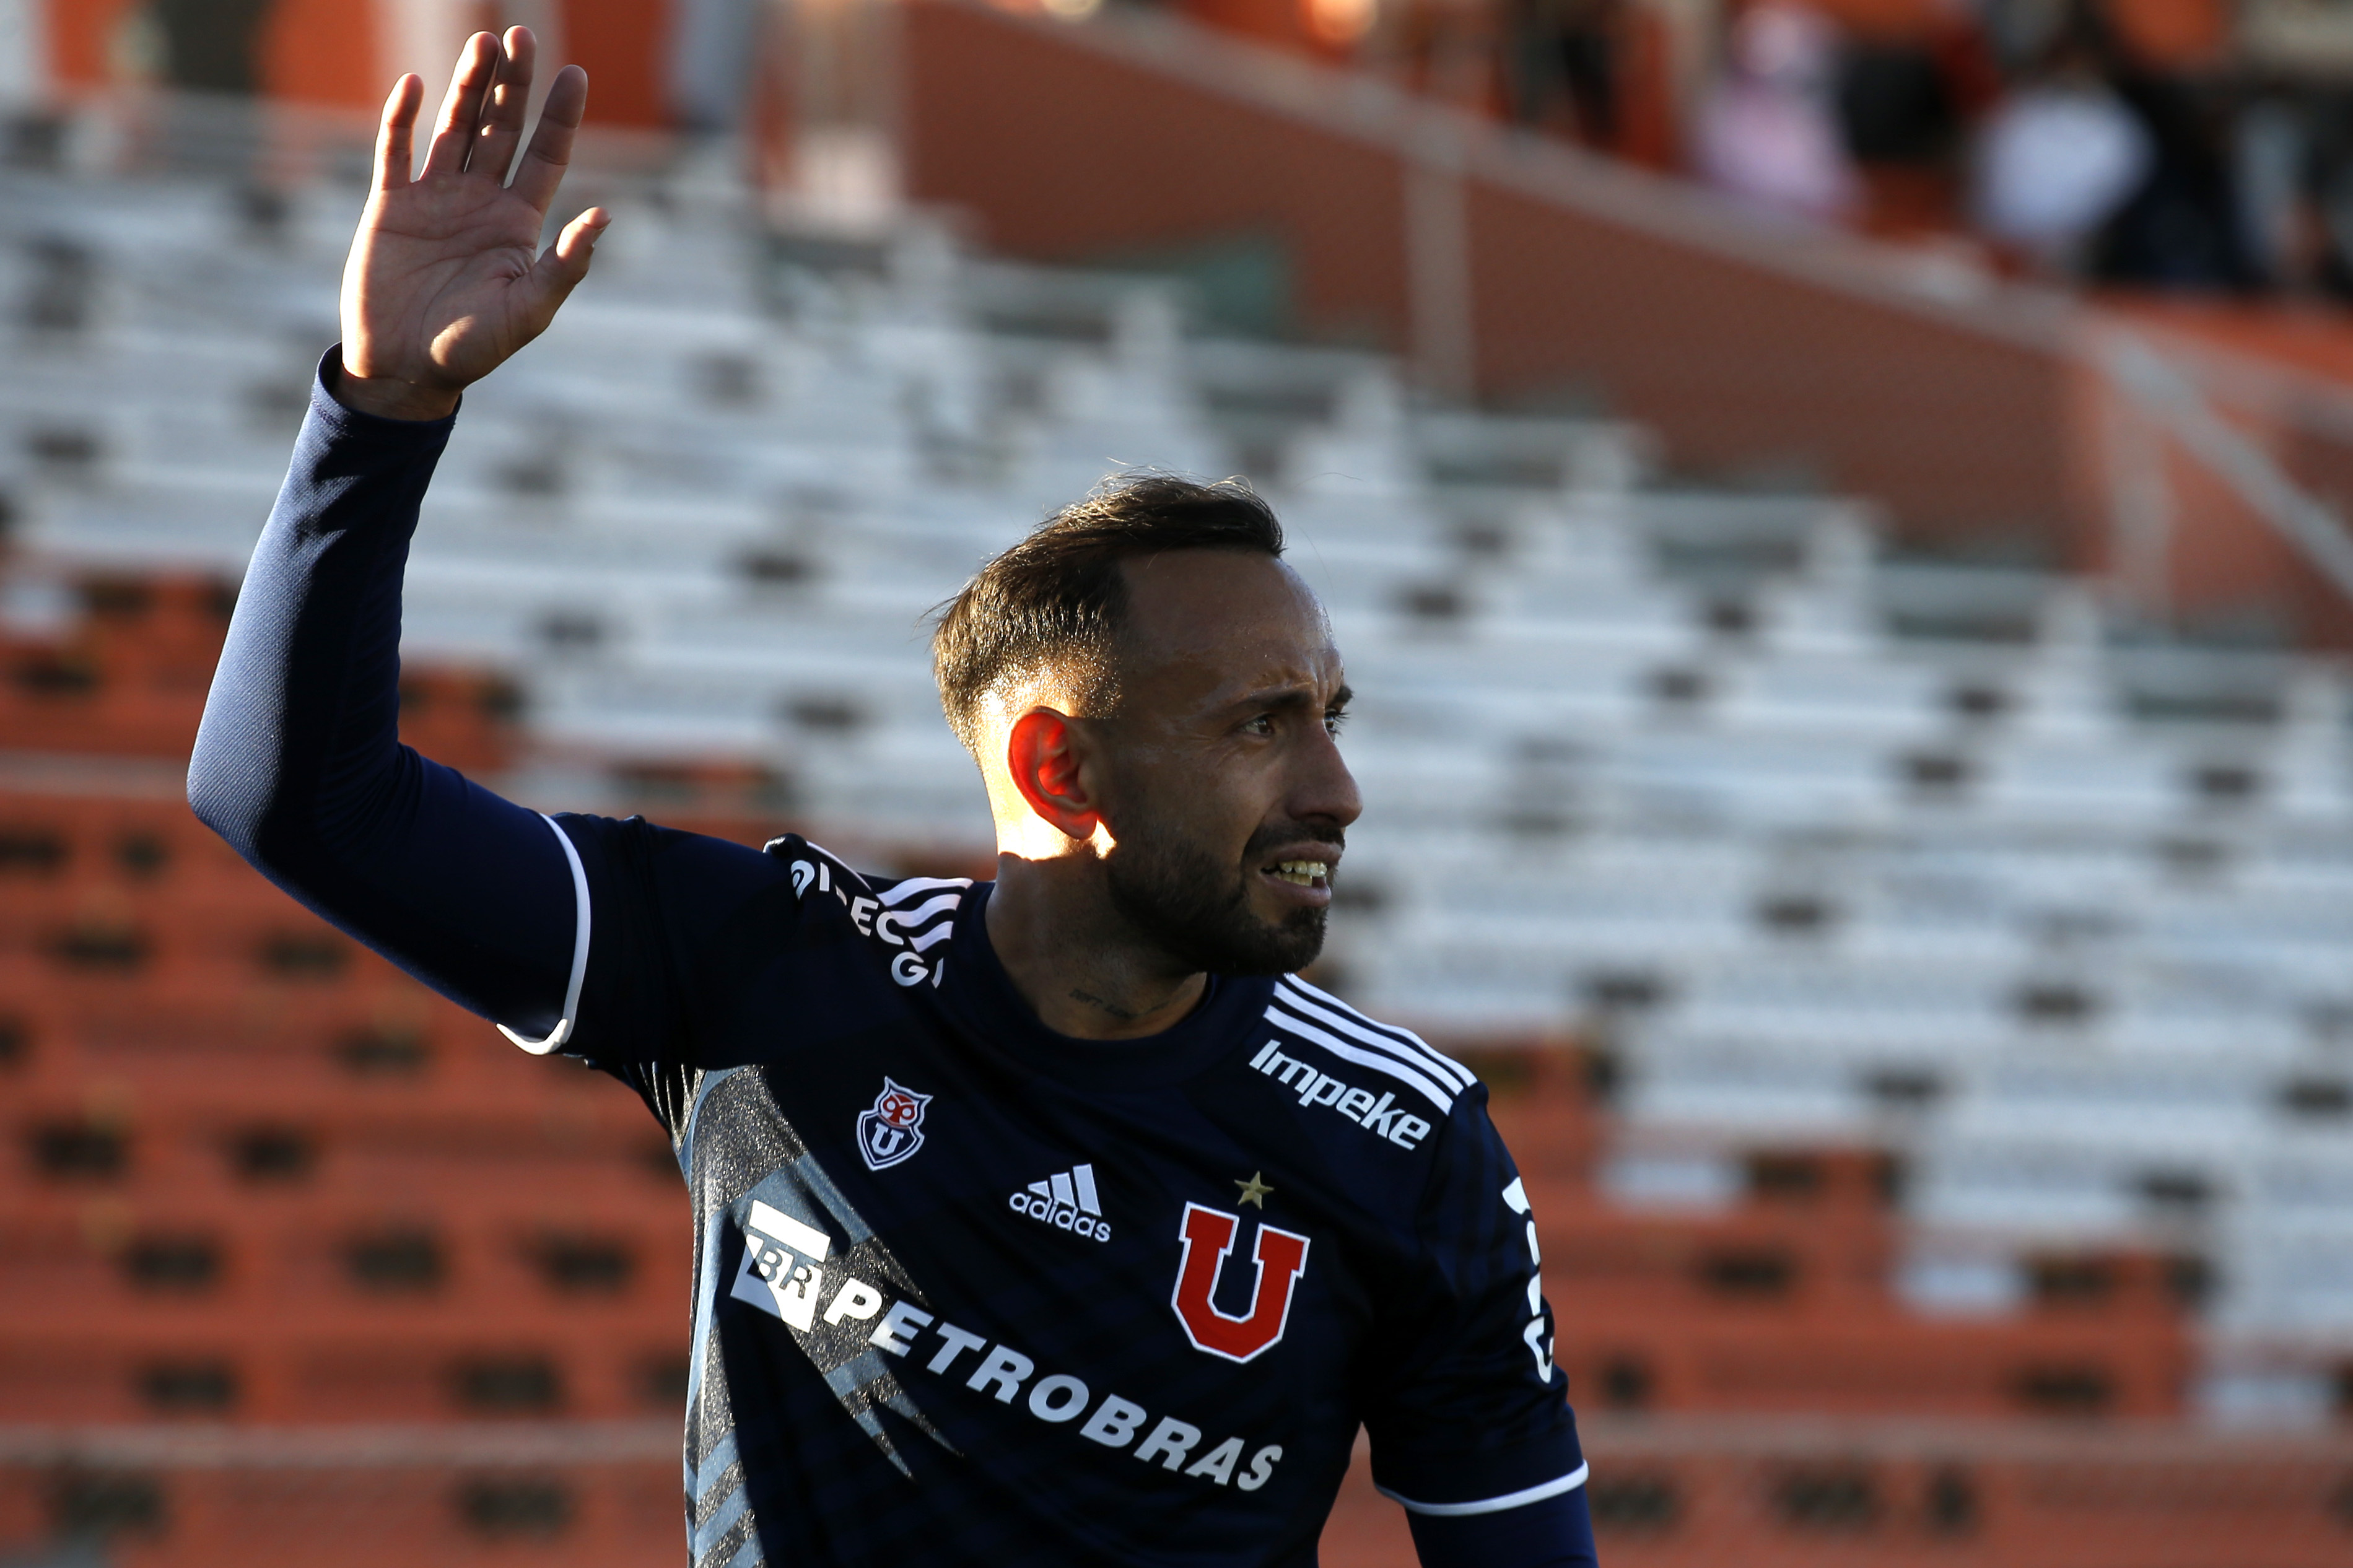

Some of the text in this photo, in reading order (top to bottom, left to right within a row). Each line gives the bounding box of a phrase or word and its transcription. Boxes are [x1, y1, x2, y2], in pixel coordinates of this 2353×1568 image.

[871, 1122, 904, 1156] U
[1249, 1039, 1431, 1151] Impeke
[1009, 1191, 1111, 1242] adidas
[1171, 1201, 1311, 1362] U
[747, 1241, 1283, 1491] BR PETROBRAS
